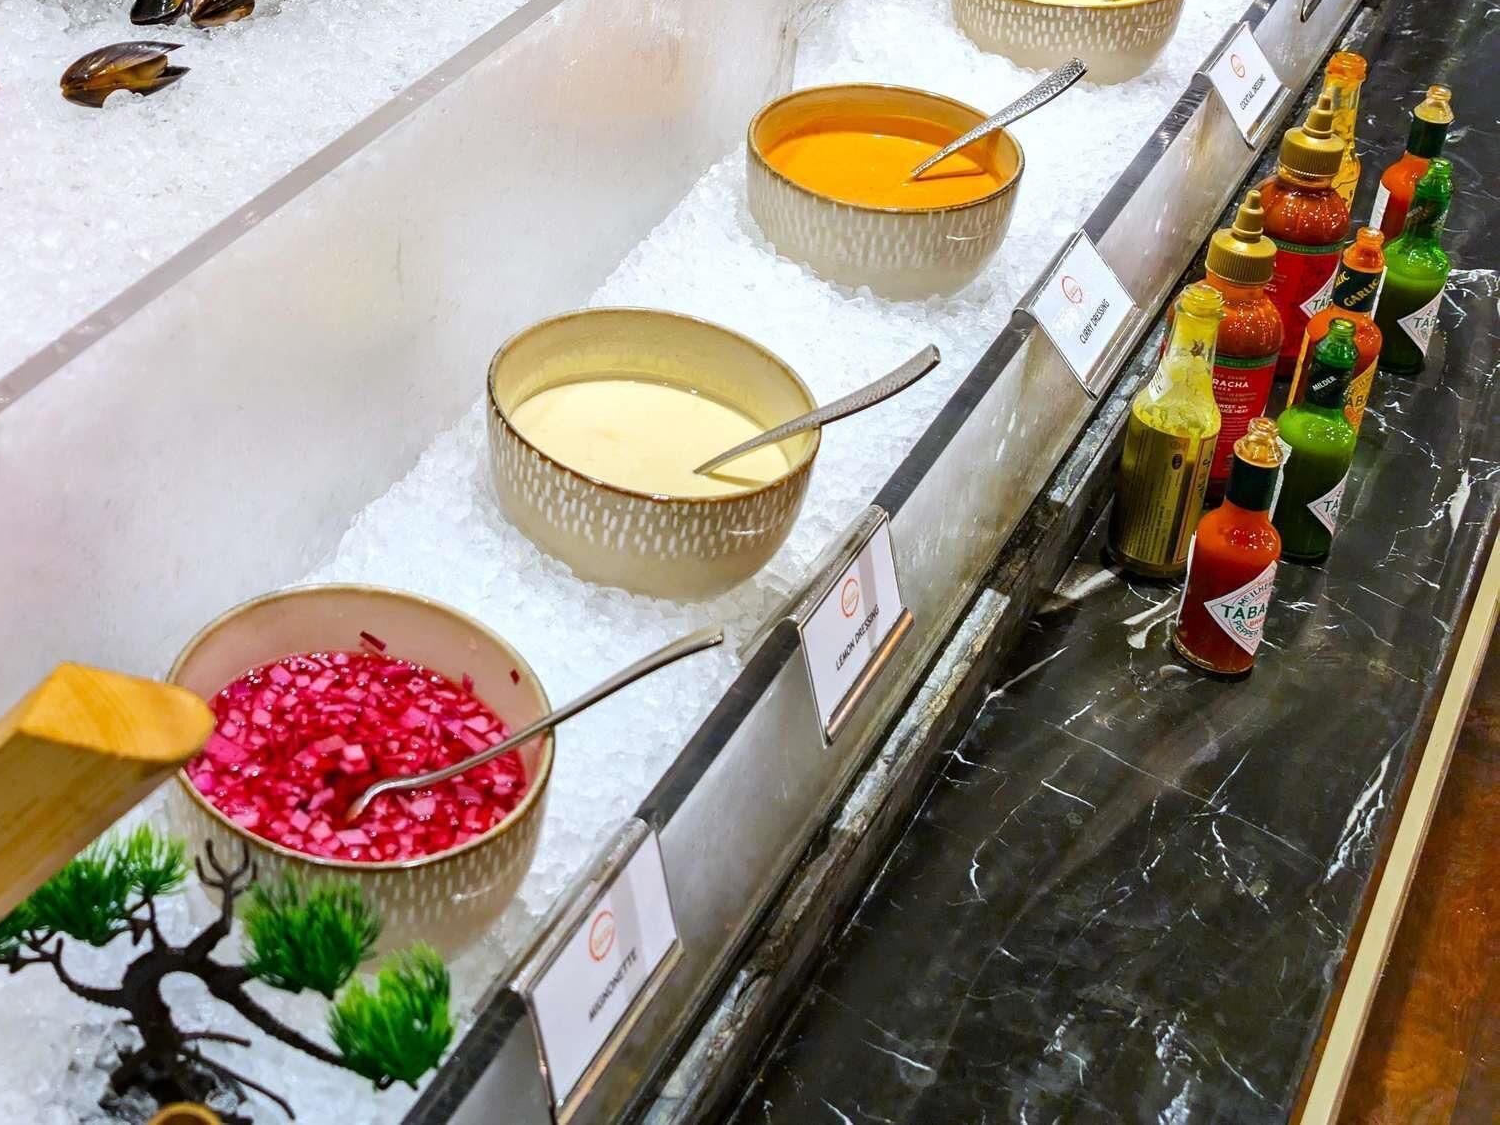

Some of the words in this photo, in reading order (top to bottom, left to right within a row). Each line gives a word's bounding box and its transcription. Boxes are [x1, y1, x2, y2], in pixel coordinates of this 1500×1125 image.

[1343, 278, 1381, 307] GARLIC
[1079, 321, 1093, 345] CURRY
[1091, 298, 1110, 327] DRESSING
[1212, 378, 1249, 388] RACHA
[1221, 603, 1268, 620] TABA
[836, 636, 855, 671] LEMON
[854, 603, 880, 644] DRESSING
